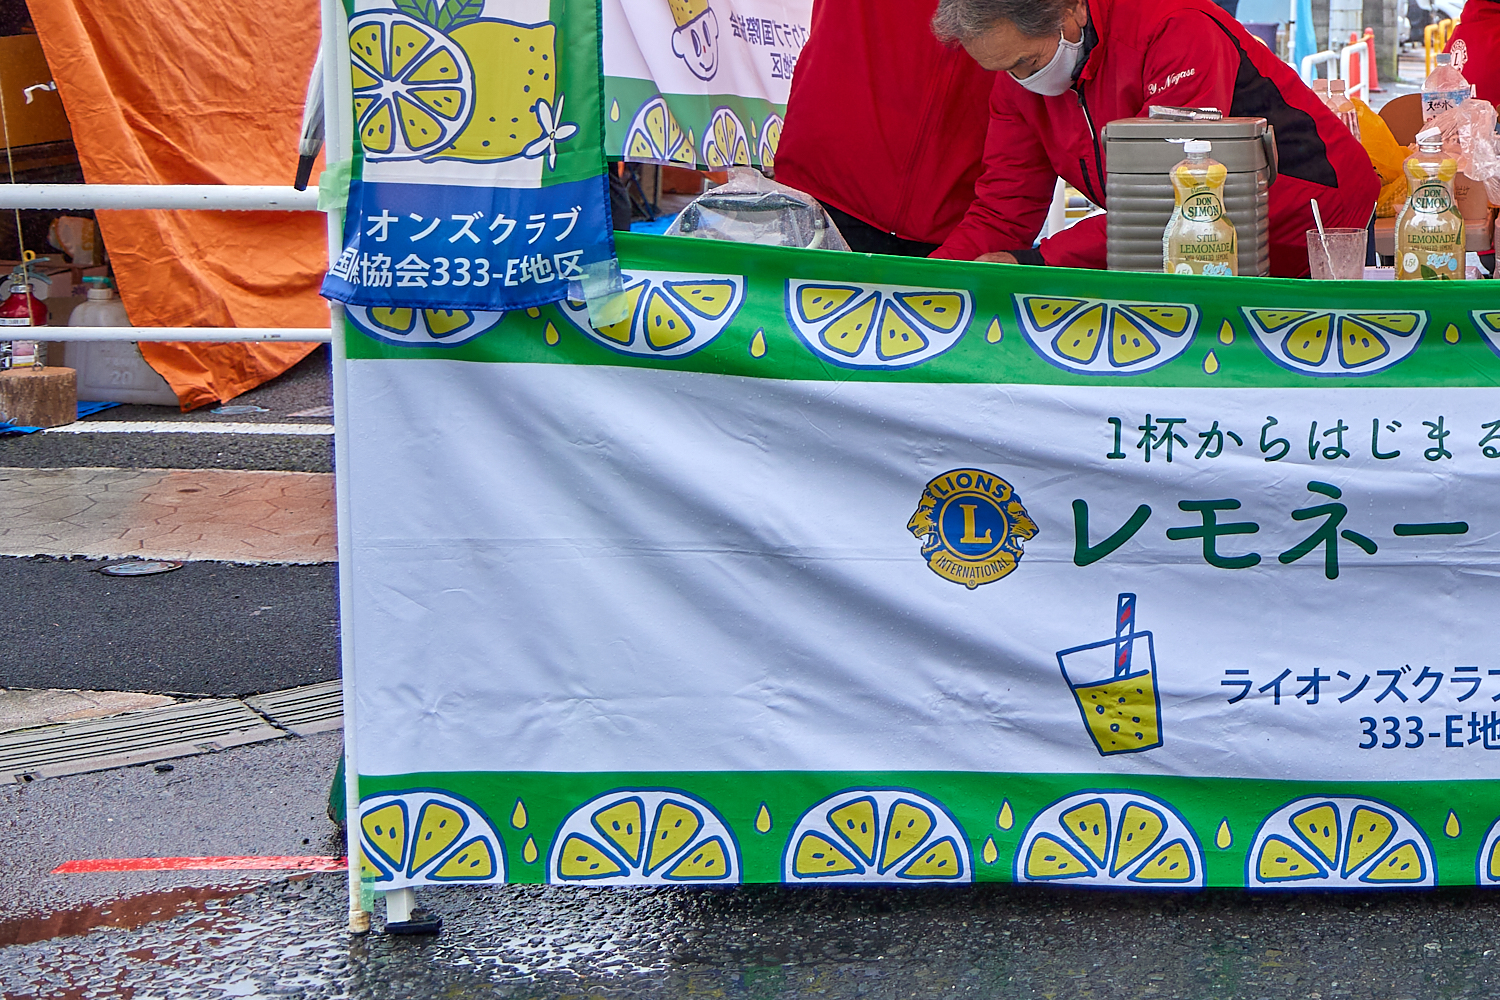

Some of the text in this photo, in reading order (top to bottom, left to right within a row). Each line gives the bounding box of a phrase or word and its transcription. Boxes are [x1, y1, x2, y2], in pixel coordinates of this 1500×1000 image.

[1426, 100, 1454, 112] 天然水
[1424, 189, 1441, 198] DON
[1196, 197, 1212, 206] DON
[1416, 197, 1448, 209] SIMON
[1187, 205, 1220, 218] SIMON
[1421, 226, 1443, 234] STILL
[1196, 234, 1219, 243] STILL
[1407, 234, 1456, 244] LEMONADE
[1180, 242, 1231, 254] LEMONADE
[933, 472, 1008, 499] LIONS
[959, 504, 992, 543] L
[935, 555, 1011, 579] INTERNATIONAL
